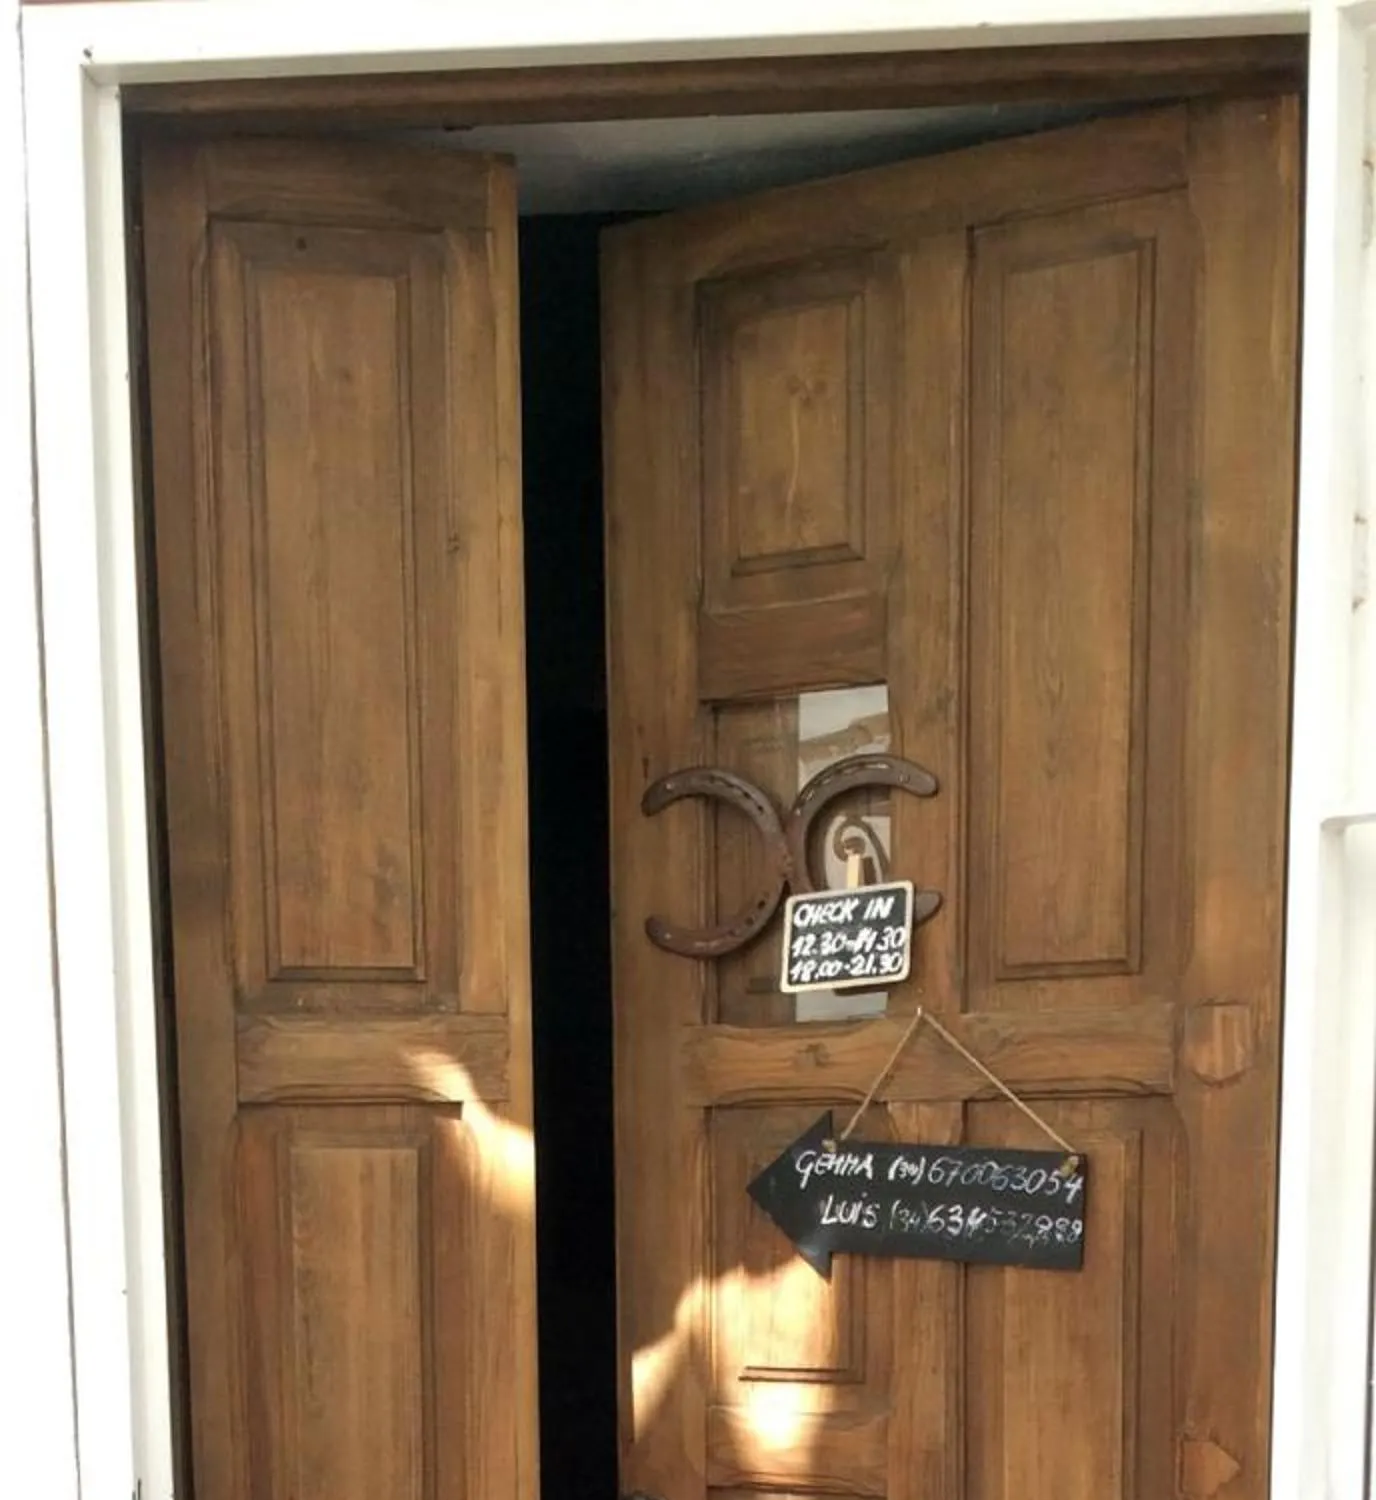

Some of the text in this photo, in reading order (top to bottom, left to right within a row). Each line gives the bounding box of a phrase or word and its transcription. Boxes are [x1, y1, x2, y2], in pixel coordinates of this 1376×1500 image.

[793, 895, 895, 927] CHECK IN
[795, 1149, 874, 1190] GEMMA
